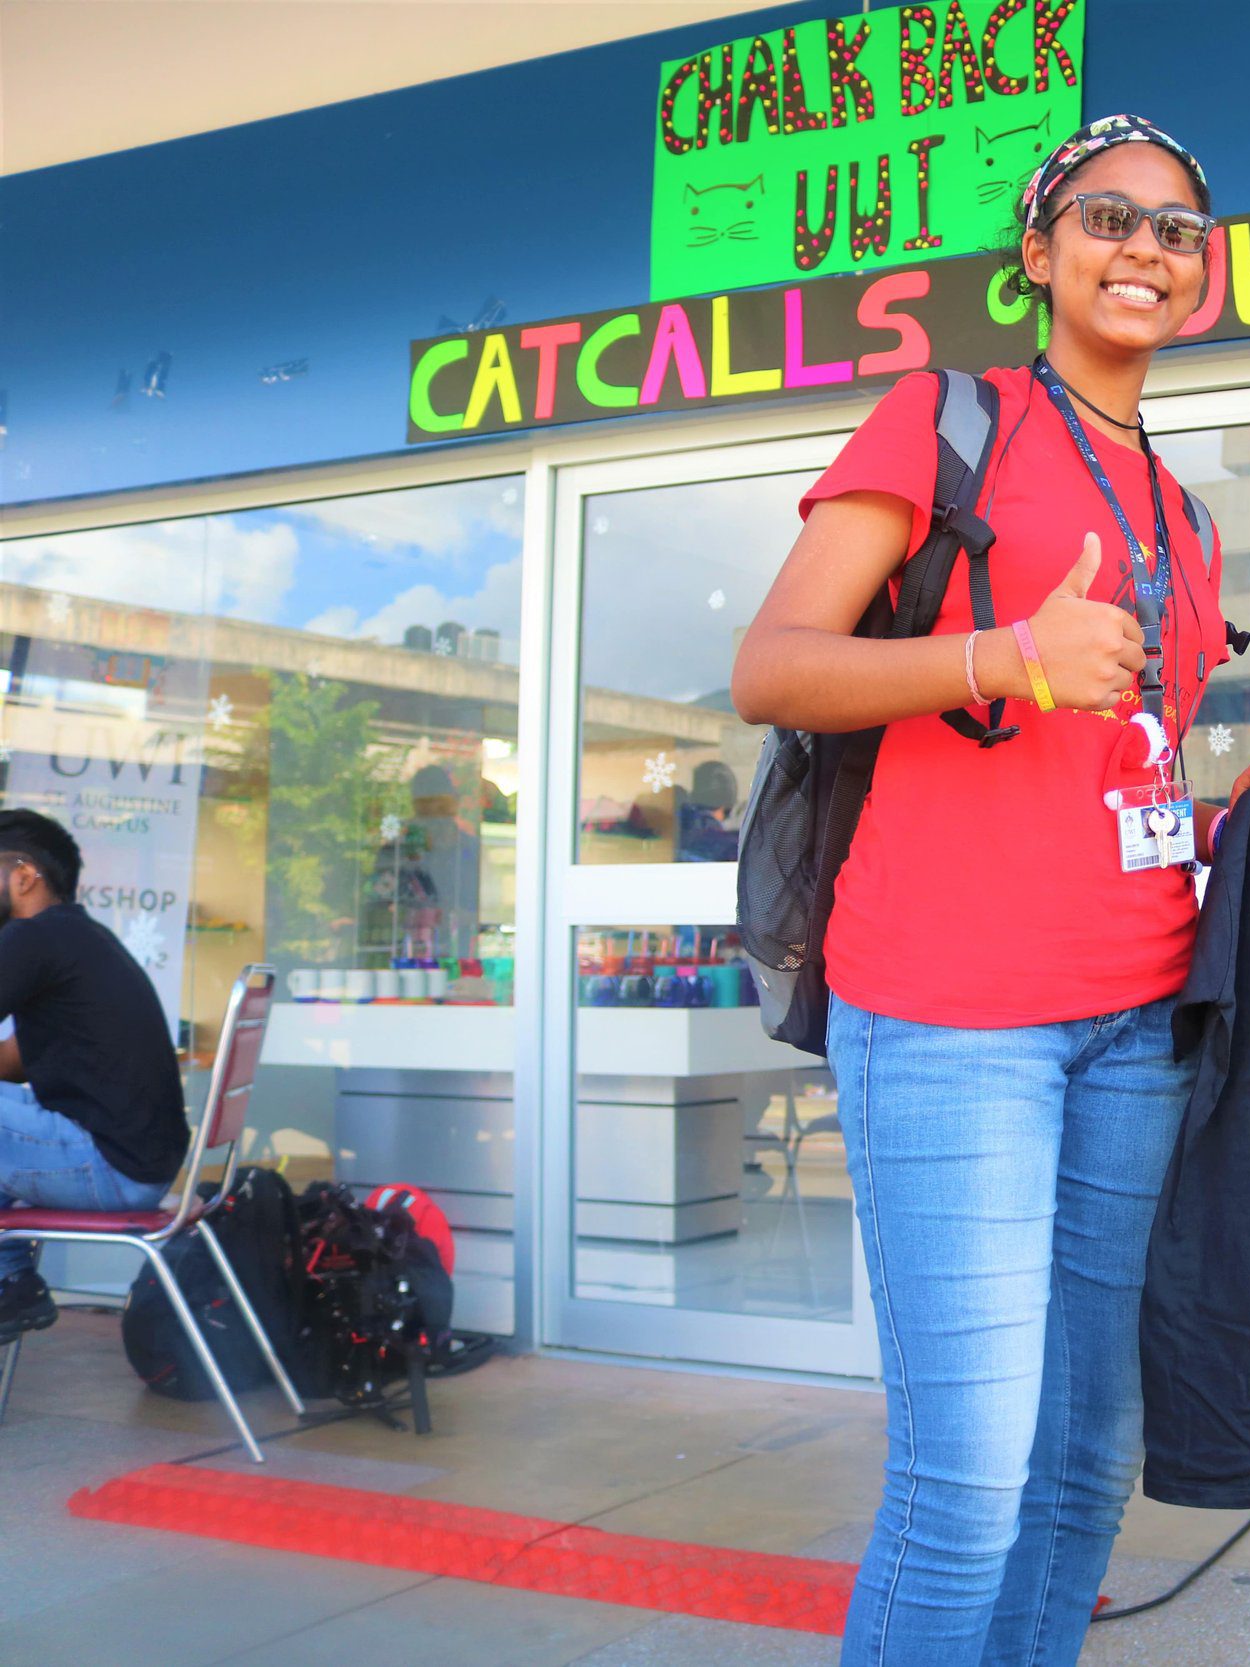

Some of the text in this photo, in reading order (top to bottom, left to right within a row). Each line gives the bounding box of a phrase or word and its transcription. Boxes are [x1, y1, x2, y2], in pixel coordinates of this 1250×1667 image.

[661, 0, 1077, 155] CHALK BACK
[794, 134, 946, 271] UWI
[409, 271, 931, 433] CATCALLS
[79, 885, 177, 912] KSHOP
